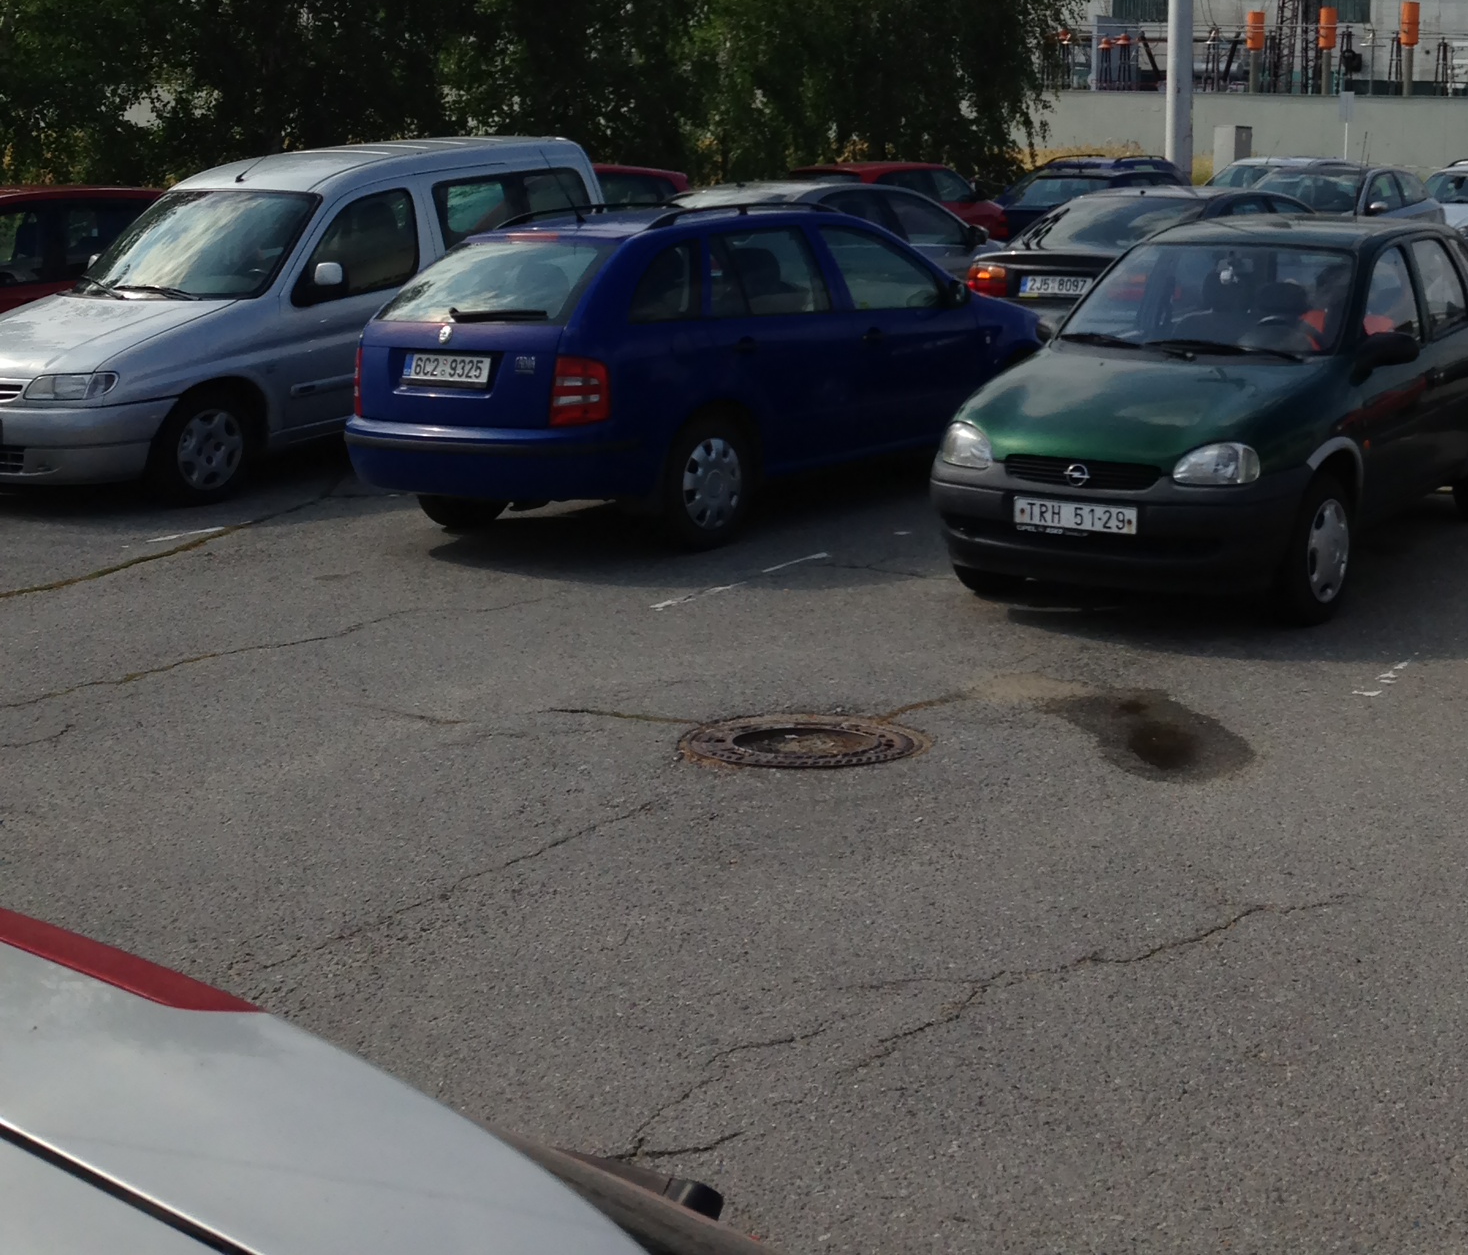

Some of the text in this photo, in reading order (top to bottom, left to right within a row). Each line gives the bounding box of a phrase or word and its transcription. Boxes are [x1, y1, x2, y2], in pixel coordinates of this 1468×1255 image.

[1029, 278, 1087, 292] 2J5 8097
[414, 357, 484, 379] 6C2 9325
[1027, 502, 1126, 531] TRH 51-29
